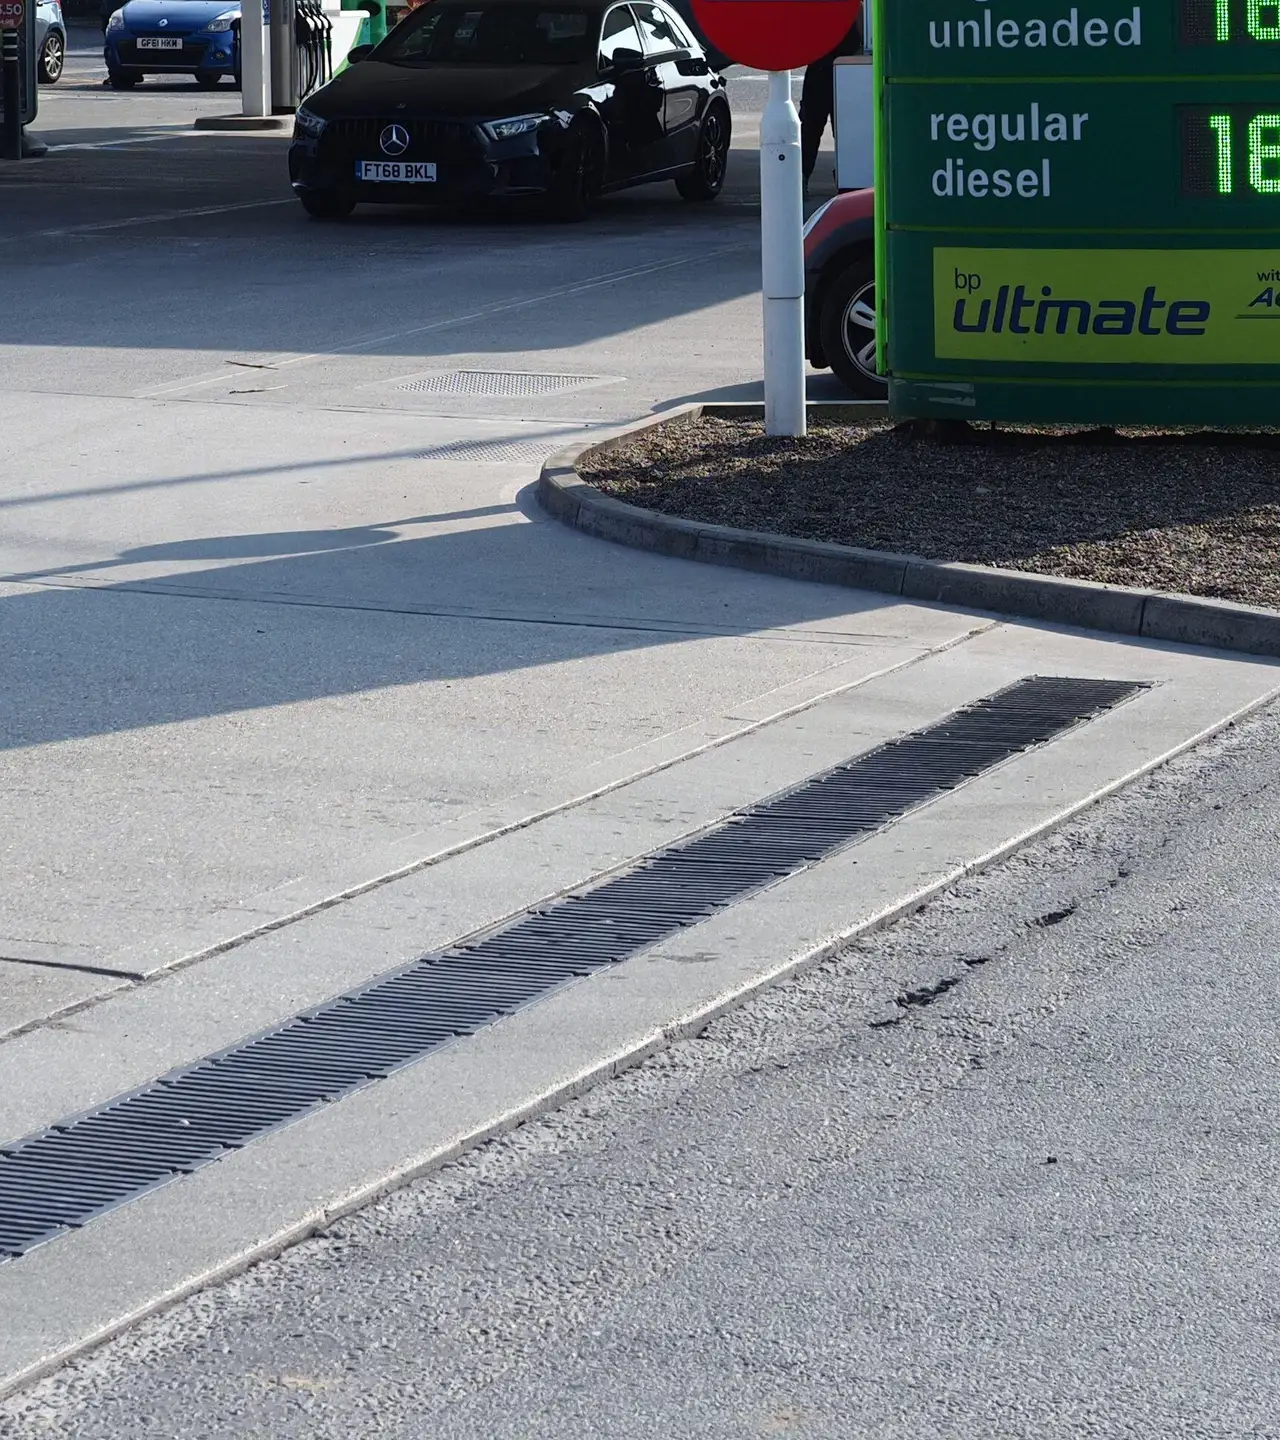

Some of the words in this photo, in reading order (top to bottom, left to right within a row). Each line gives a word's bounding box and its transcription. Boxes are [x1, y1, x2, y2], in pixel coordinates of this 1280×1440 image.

[929, 6, 1141, 48] unleaded
[930, 102, 1089, 151] regular
[364, 162, 400, 178] FT68
[404, 164, 434, 179] BKL
[931, 158, 1051, 198] diesel
[954, 267, 981, 294] bp
[953, 284, 1210, 337] ultimate
